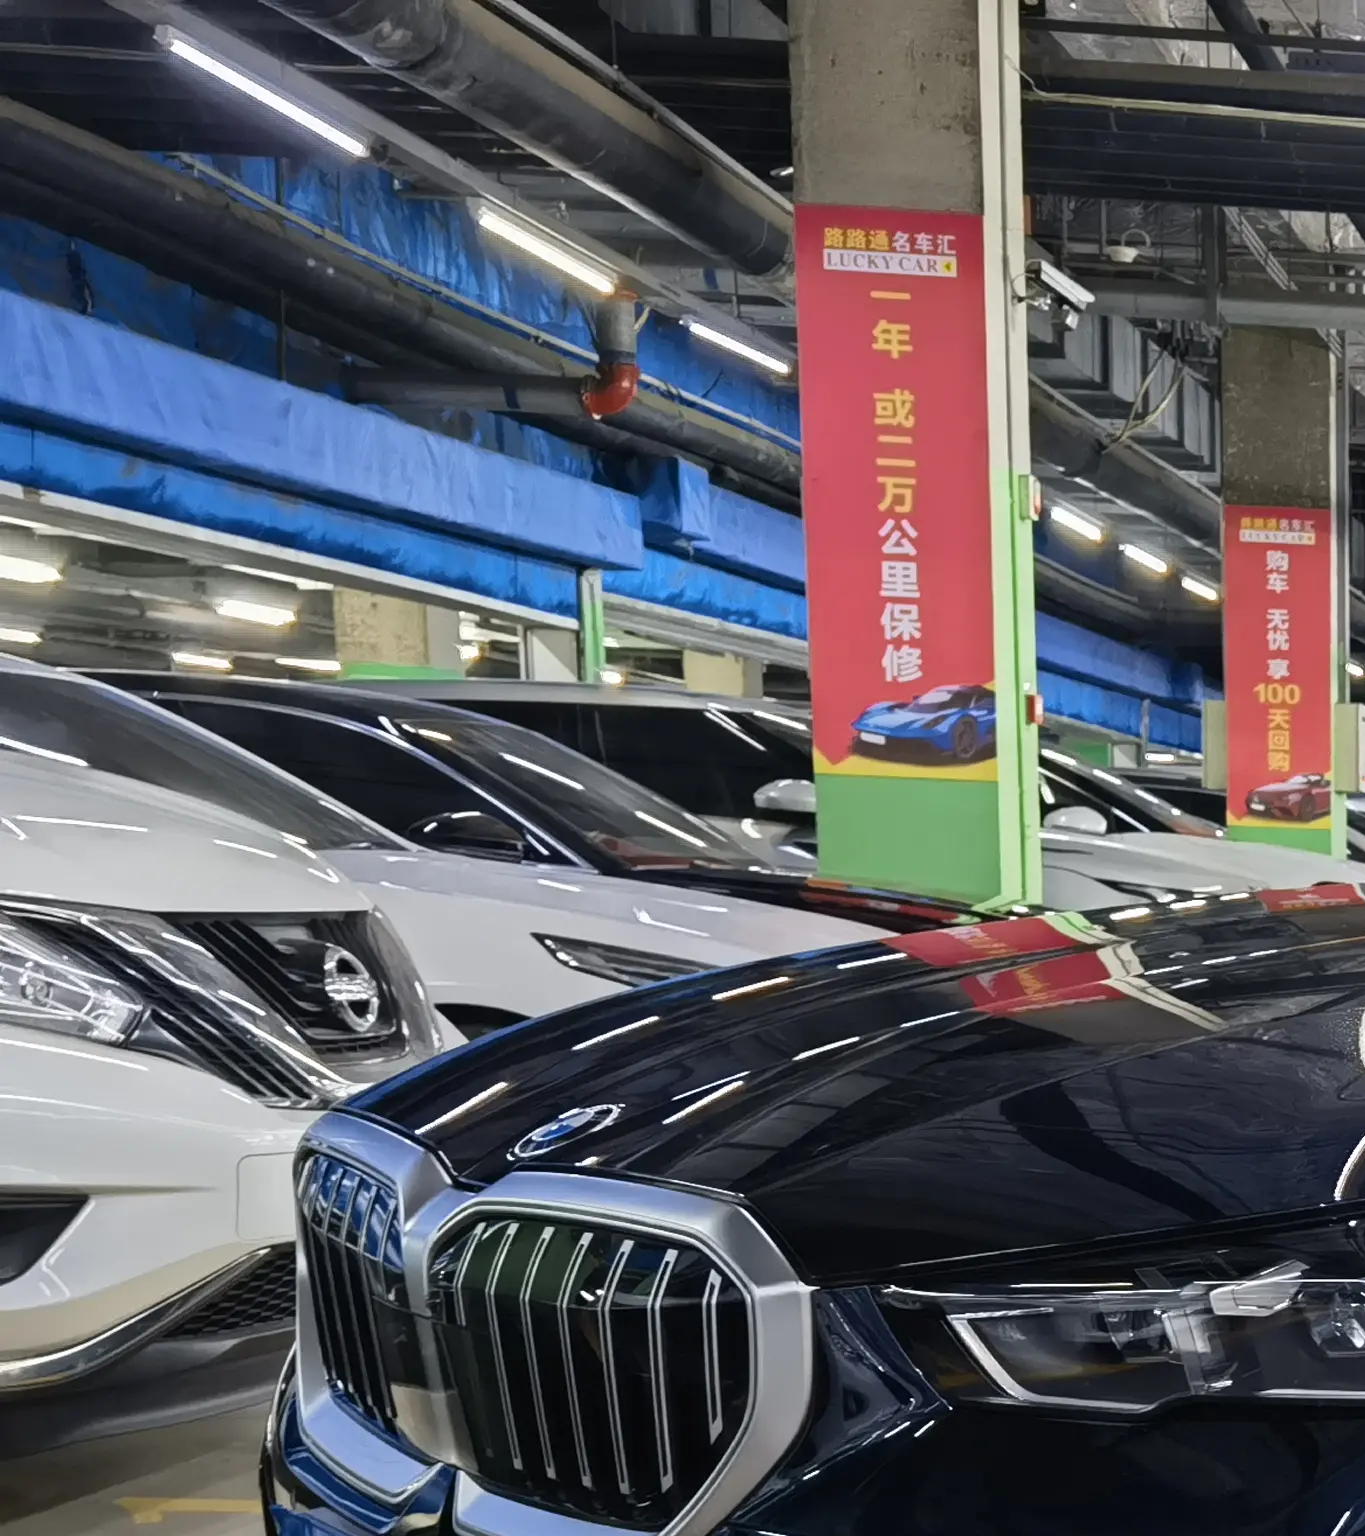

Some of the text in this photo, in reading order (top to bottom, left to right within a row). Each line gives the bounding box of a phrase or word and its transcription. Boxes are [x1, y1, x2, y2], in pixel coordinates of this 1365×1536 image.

[824, 227, 956, 255] 路路通名车汇
[826, 251, 939, 274] LUCKY CAR
